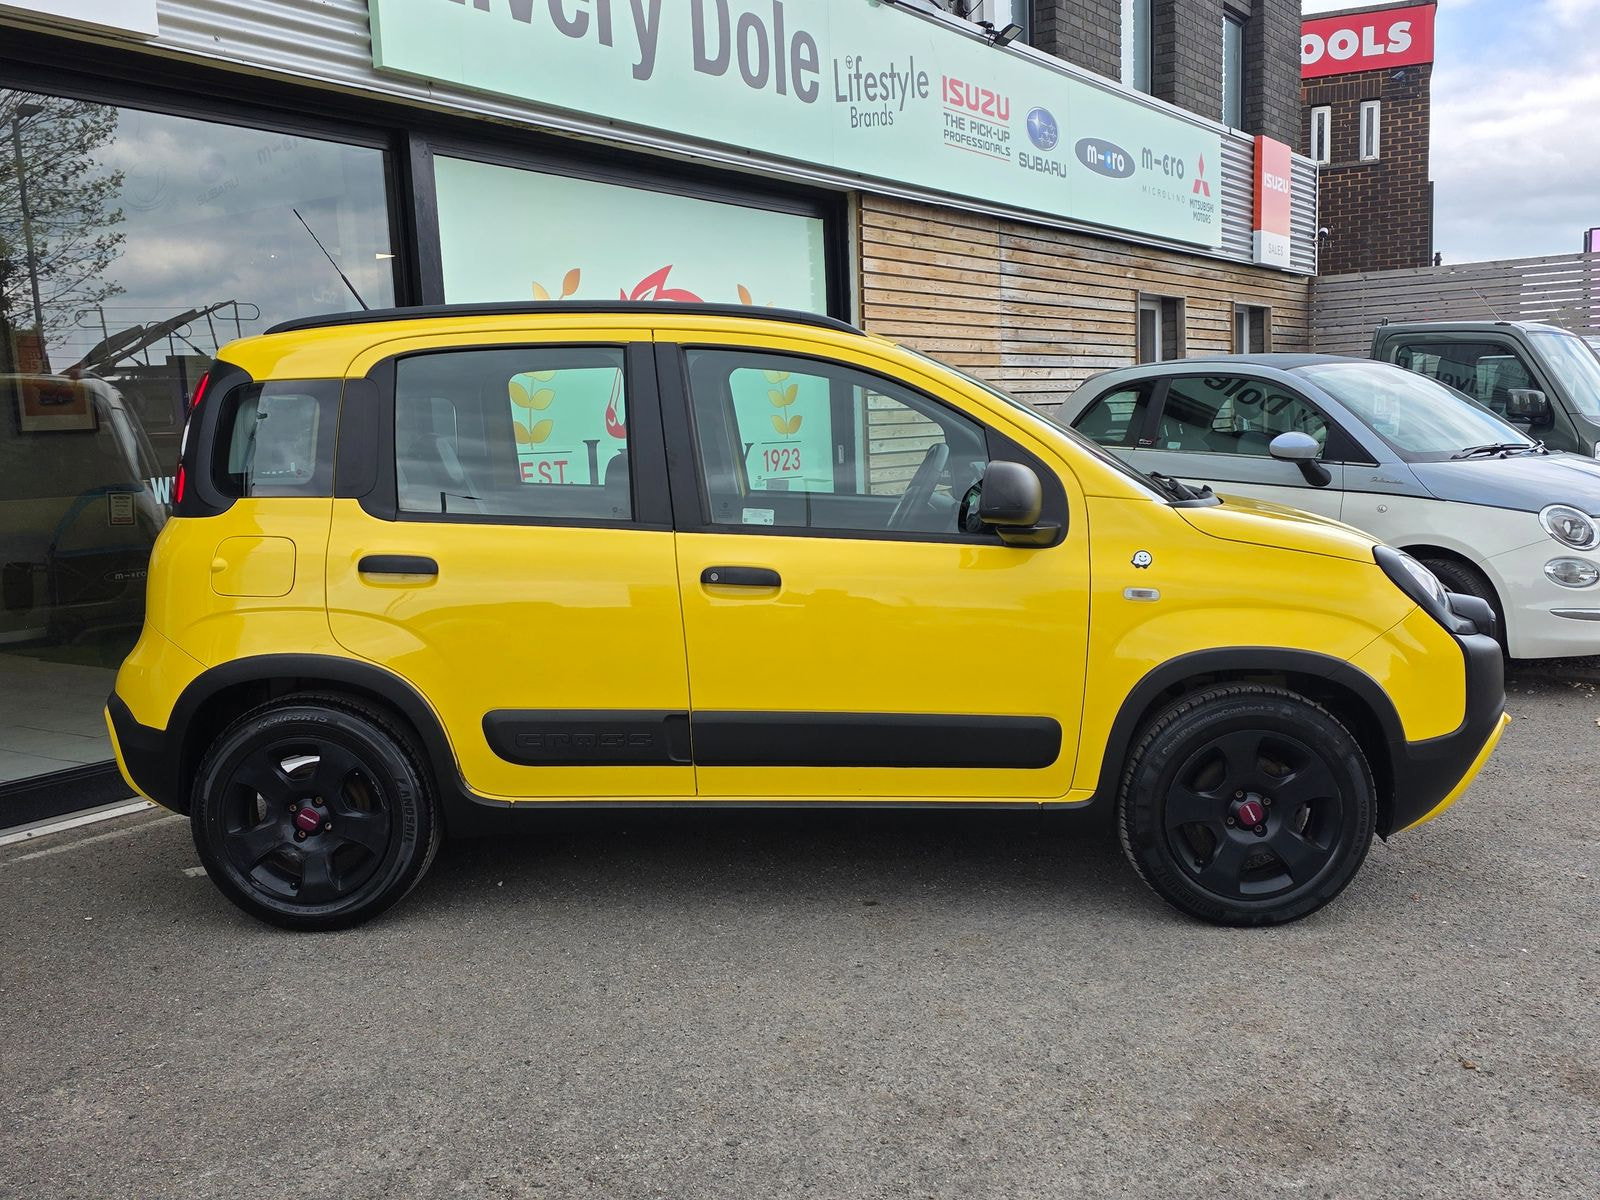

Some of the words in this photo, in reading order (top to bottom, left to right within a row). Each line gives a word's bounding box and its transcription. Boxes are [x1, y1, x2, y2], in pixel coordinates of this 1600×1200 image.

[691, 0, 820, 104] Dole
[833, 54, 930, 112] Lifestyle
[941, 75, 1011, 121] ISUZU
[849, 103, 894, 129] Brands
[943, 112, 966, 131] THE
[969, 119, 1011, 143] PICK-UP
[943, 129, 1012, 157] PROFESSIONALS
[1018, 152, 1067, 178] SUBARU
[1263, 172, 1289, 194] ISUZU
[1189, 198, 1215, 213] MITSUBISHI
[1192, 210, 1212, 224] MOTORS
[1267, 243, 1284, 256] SALES
[762, 447, 802, 473] 1923
